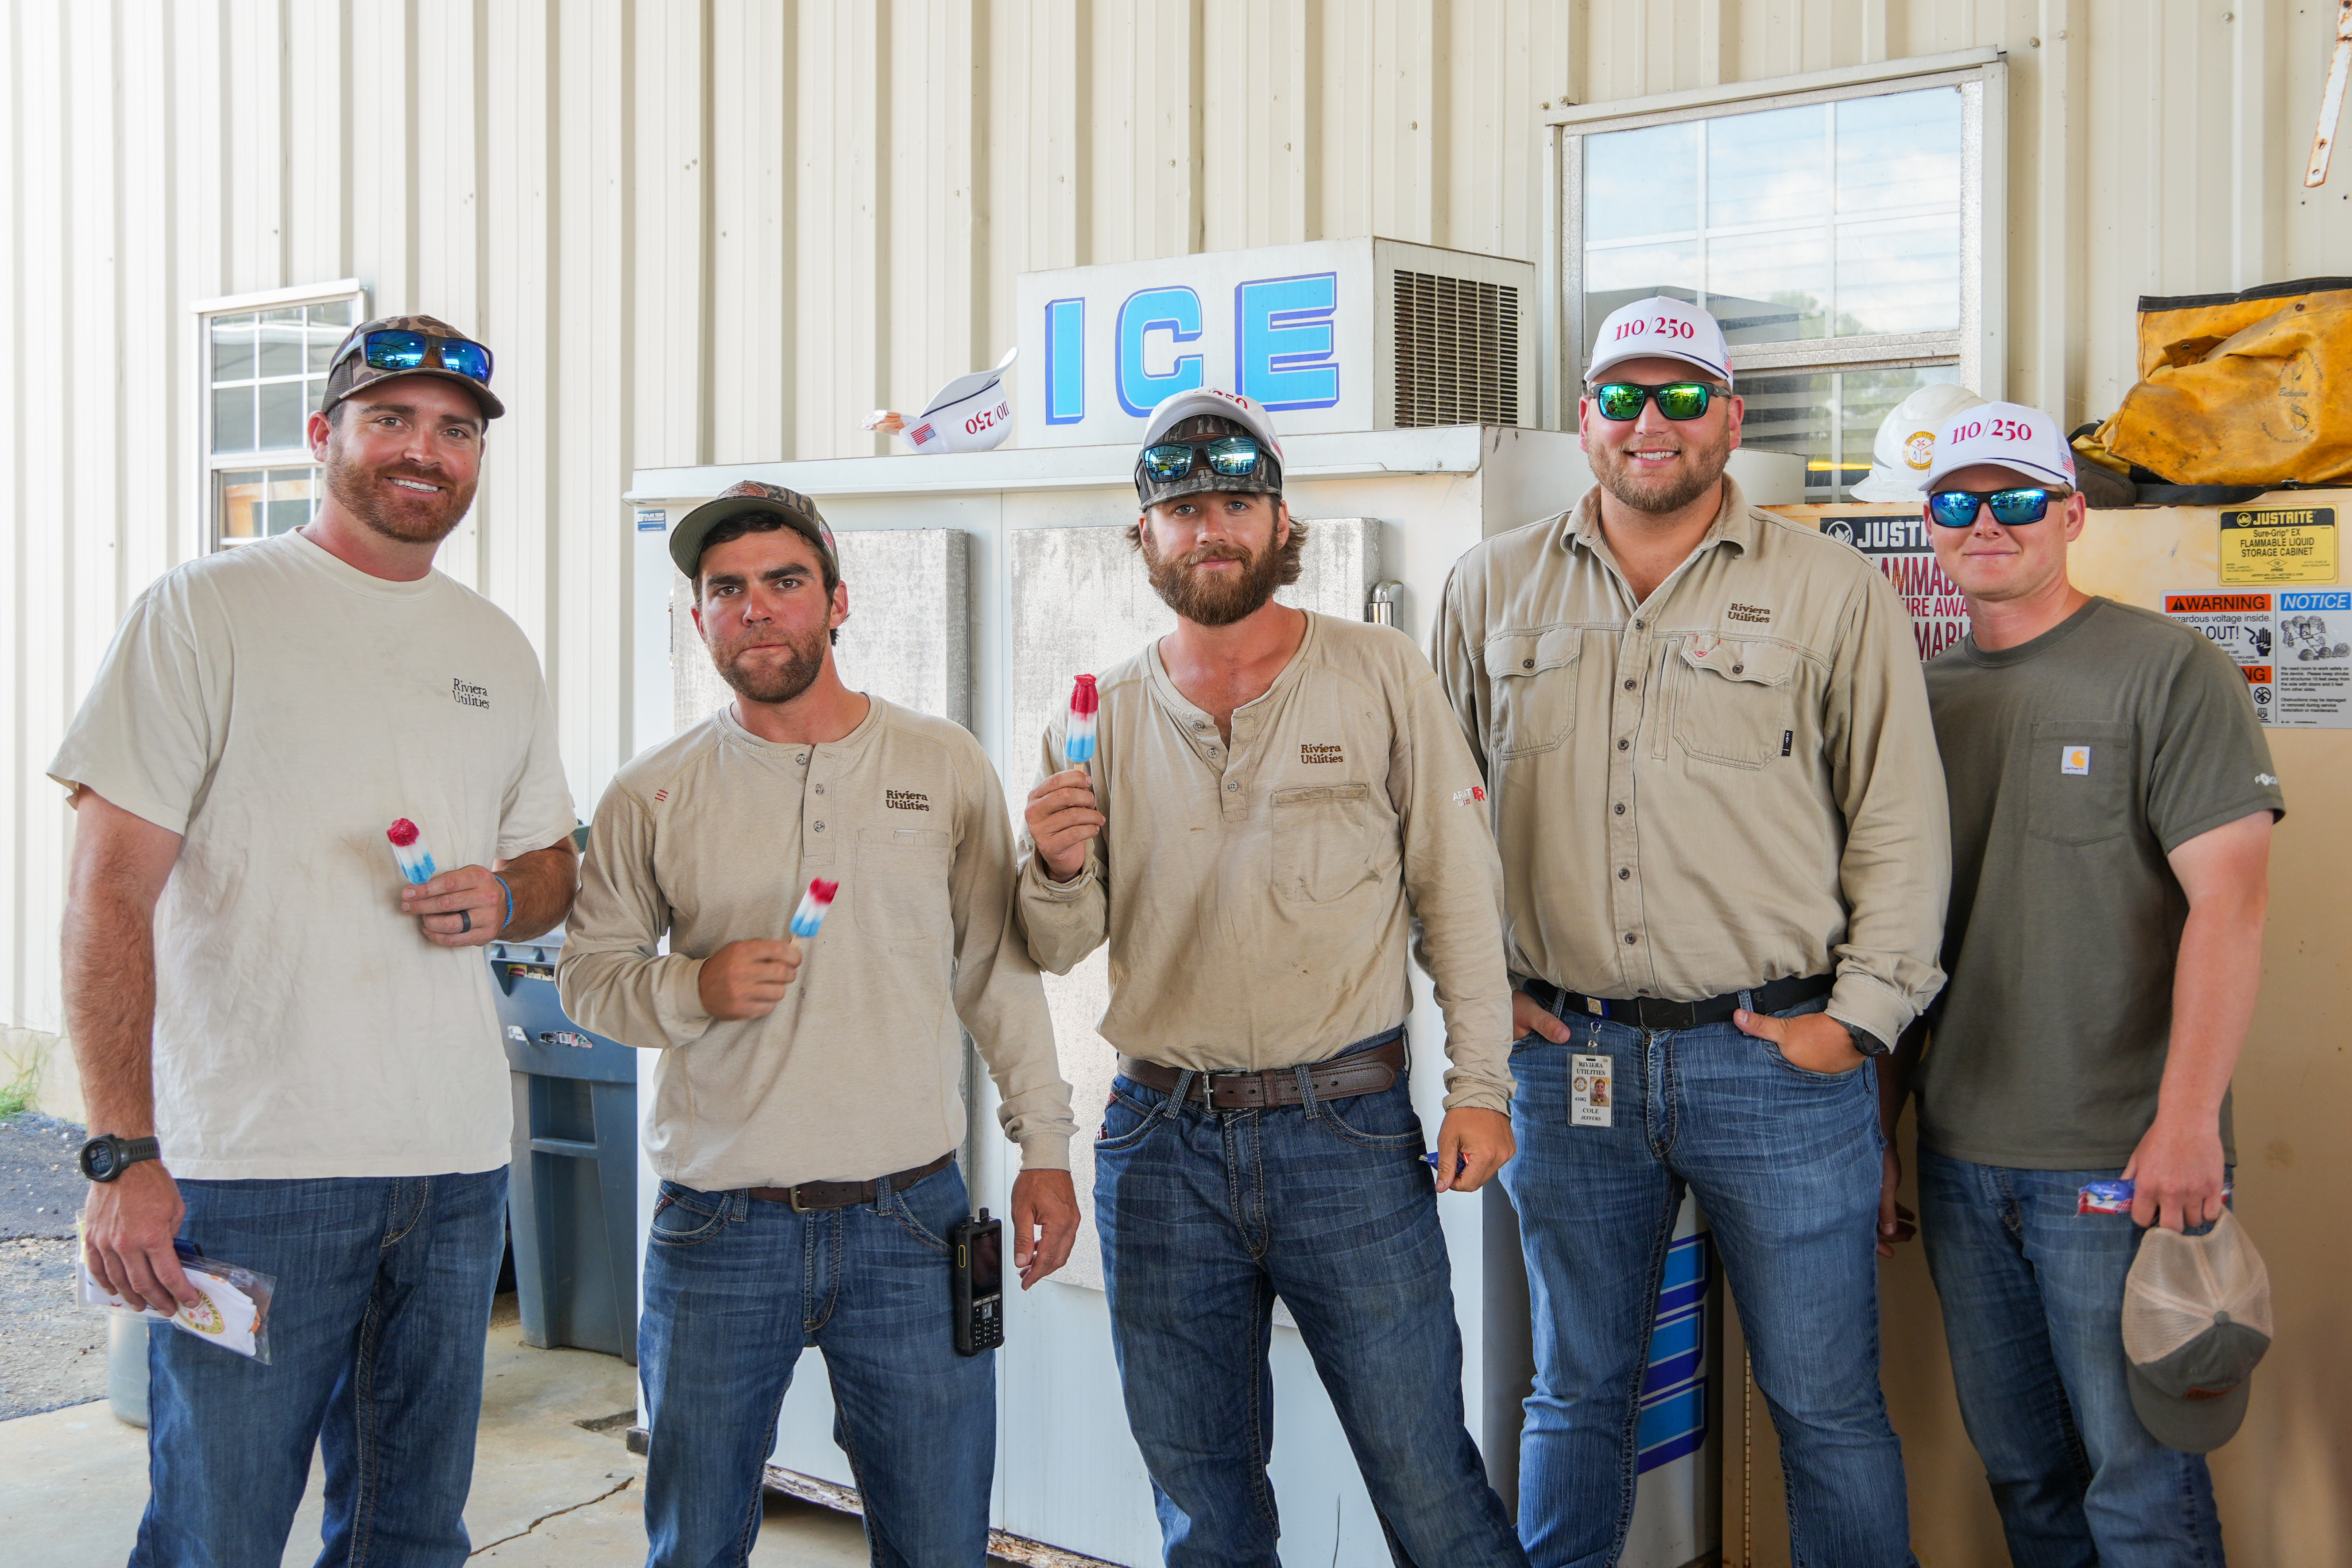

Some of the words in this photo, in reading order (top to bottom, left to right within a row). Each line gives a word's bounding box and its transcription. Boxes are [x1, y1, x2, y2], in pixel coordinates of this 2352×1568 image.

[1614, 316, 1694, 341] 110/250
[1045, 272, 1339, 426] ICE
[966, 400, 1010, 434] 110/250
[1951, 419, 2032, 445] 110/250
[2253, 511, 2313, 525] JUSTRITE
[2240, 538, 2286, 548] FLAMMABLE
[2289, 537, 2314, 546] LIQUID
[2241, 549, 2277, 557] STORAGE
[2280, 547, 2313, 556] CABINET
[1730, 603, 1771, 614] Riviera
[2185, 596, 2265, 610] WARNING
[2283, 594, 2348, 609] NOTICE
[1728, 611, 1770, 623] Utilities
[2212, 615, 2242, 624] voltage
[2206, 626, 2239, 640] OUT!
[453, 678, 488, 697] Riviera
[452, 690, 490, 709] Utilities
[1300, 743, 1342, 753] Riviera
[1300, 753, 1343, 764] Utilities
[886, 790, 928, 801] Riviera
[886, 799, 929, 811] Utilities
